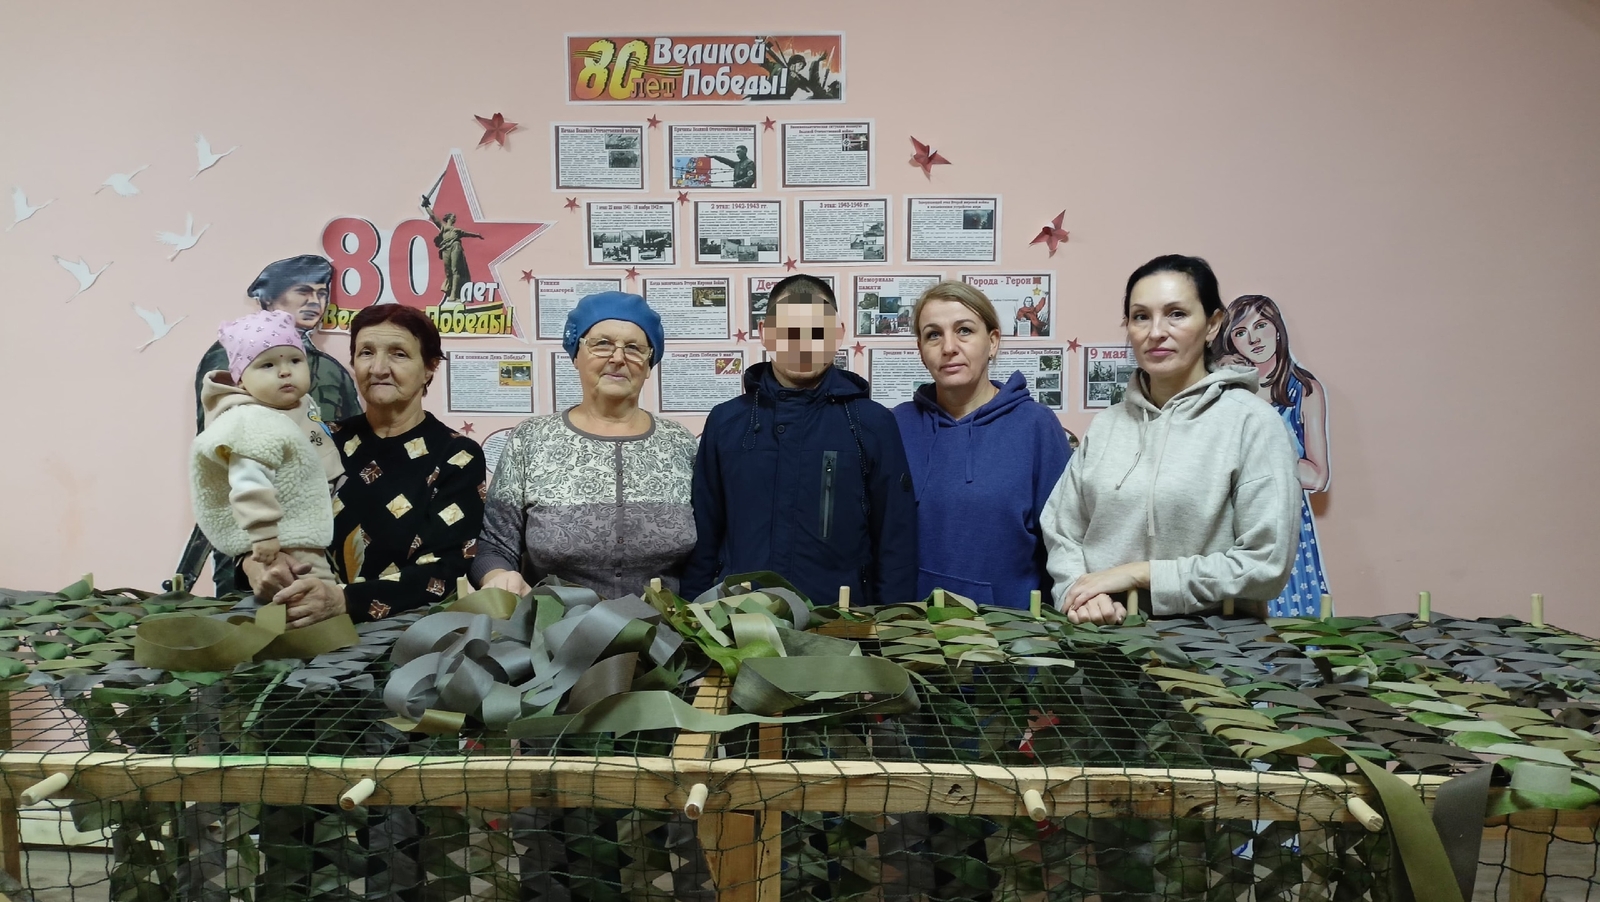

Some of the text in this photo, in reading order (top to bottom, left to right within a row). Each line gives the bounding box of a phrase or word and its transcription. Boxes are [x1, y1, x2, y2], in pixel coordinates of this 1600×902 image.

[654, 38, 766, 65] Великой
[575, 38, 676, 99] 80 лет
[682, 68, 788, 98] Победы!
[323, 218, 447, 310] 80
[461, 281, 498, 303] лет
[756, 279, 779, 291] Дет
[968, 277, 998, 287] Города
[1006, 277, 1031, 287] Герои
[426, 304, 513, 334] Победы!
[1090, 348, 1128, 359] 9 мая
